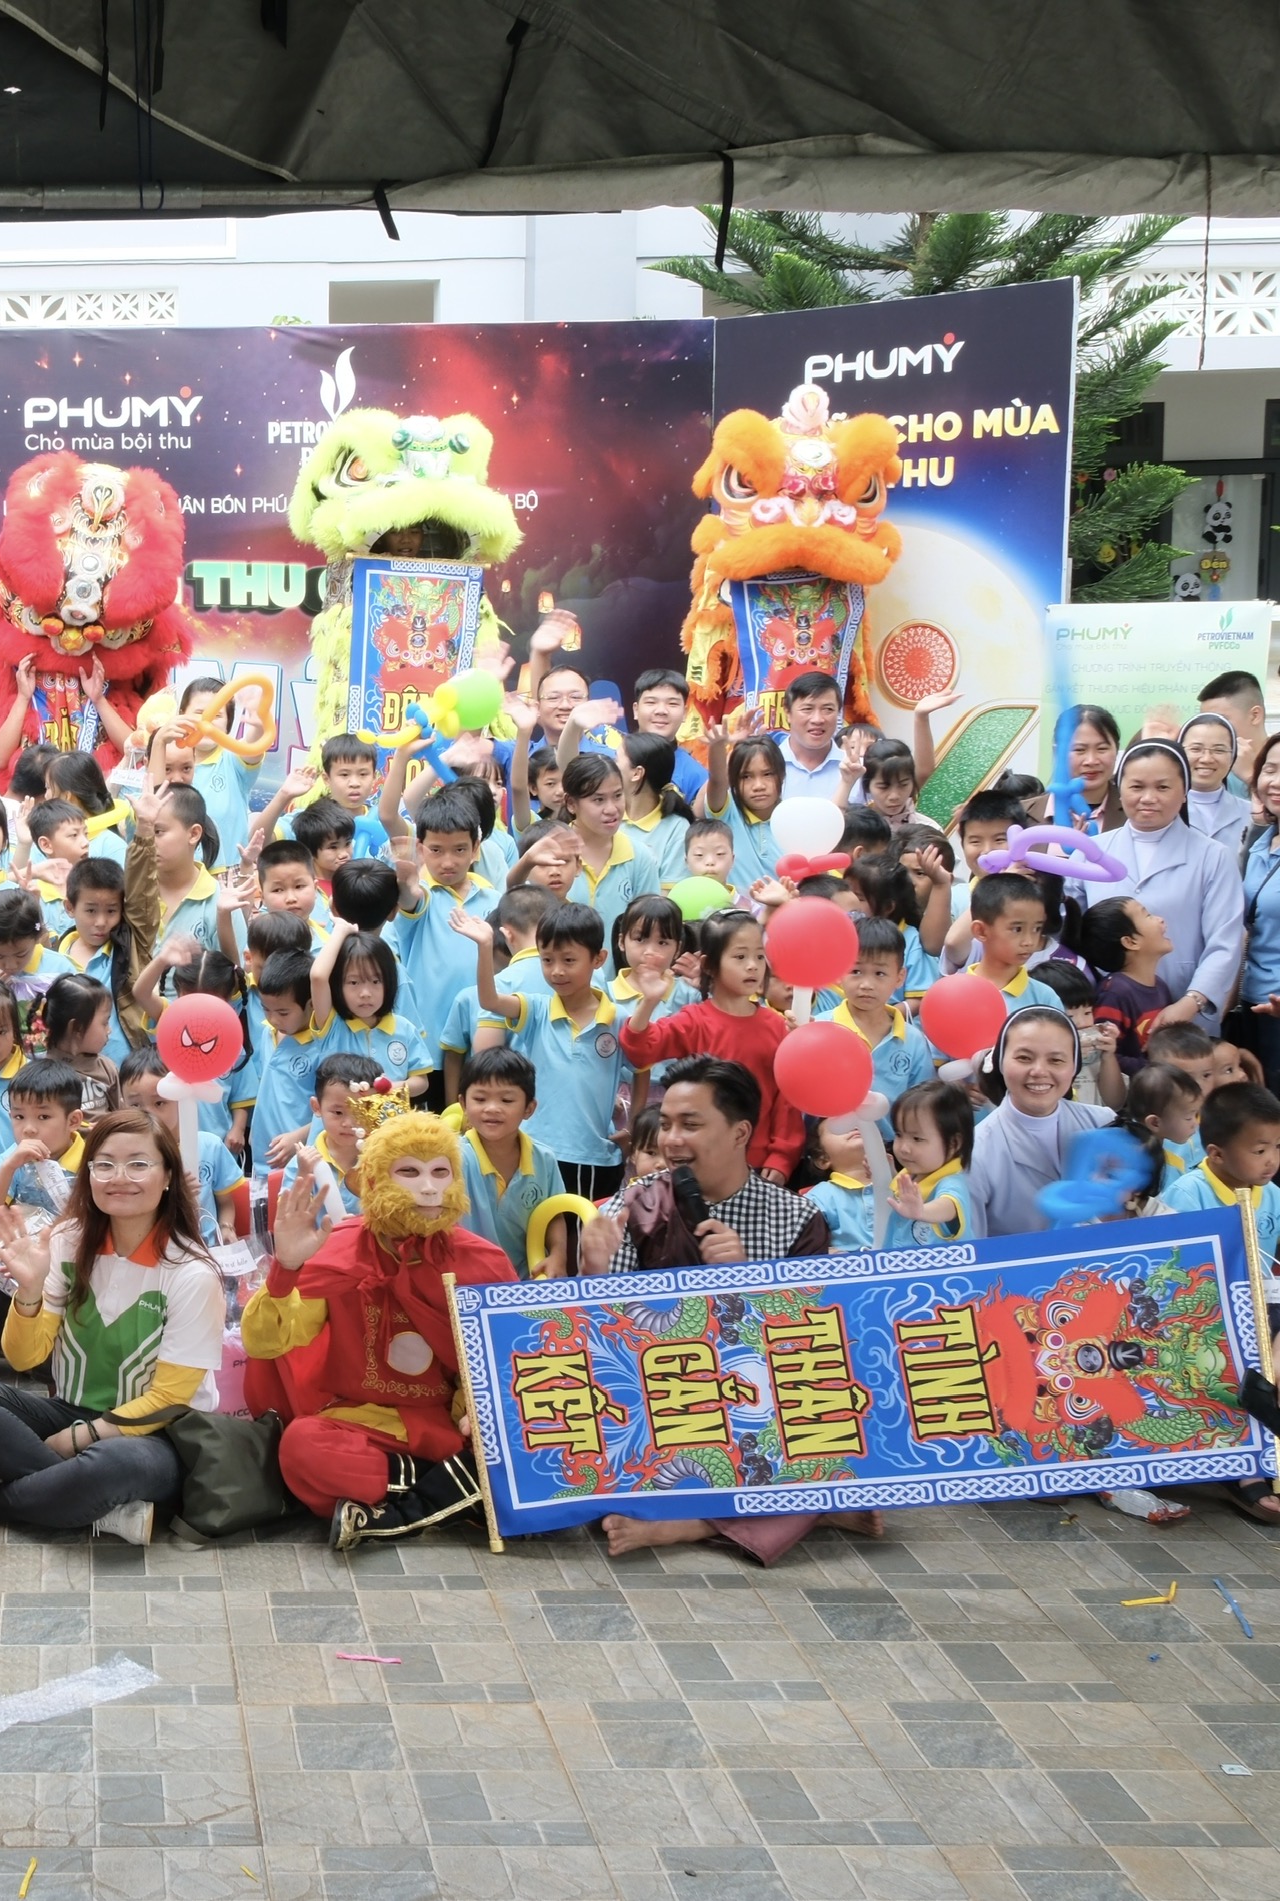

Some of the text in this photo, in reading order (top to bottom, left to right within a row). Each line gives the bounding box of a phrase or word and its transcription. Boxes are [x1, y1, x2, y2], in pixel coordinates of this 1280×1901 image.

[25, 433, 192, 453] Cho mùa bội thu
[889, 398, 1060, 445] CHO MÙA
[178, 494, 205, 514] ÂN
[211, 493, 246, 514] BÓN
[252, 493, 289, 514] PHÚ
[514, 489, 539, 512] BỘ
[193, 560, 307, 609] THU
[1197, 631, 1254, 641] PETROVIETNAM
[641, 1340, 757, 1449] GẮN
[765, 1306, 869, 1459] THÂN
[897, 1305, 999, 1440] TÌNH
[514, 1351, 625, 1455] KẾT
